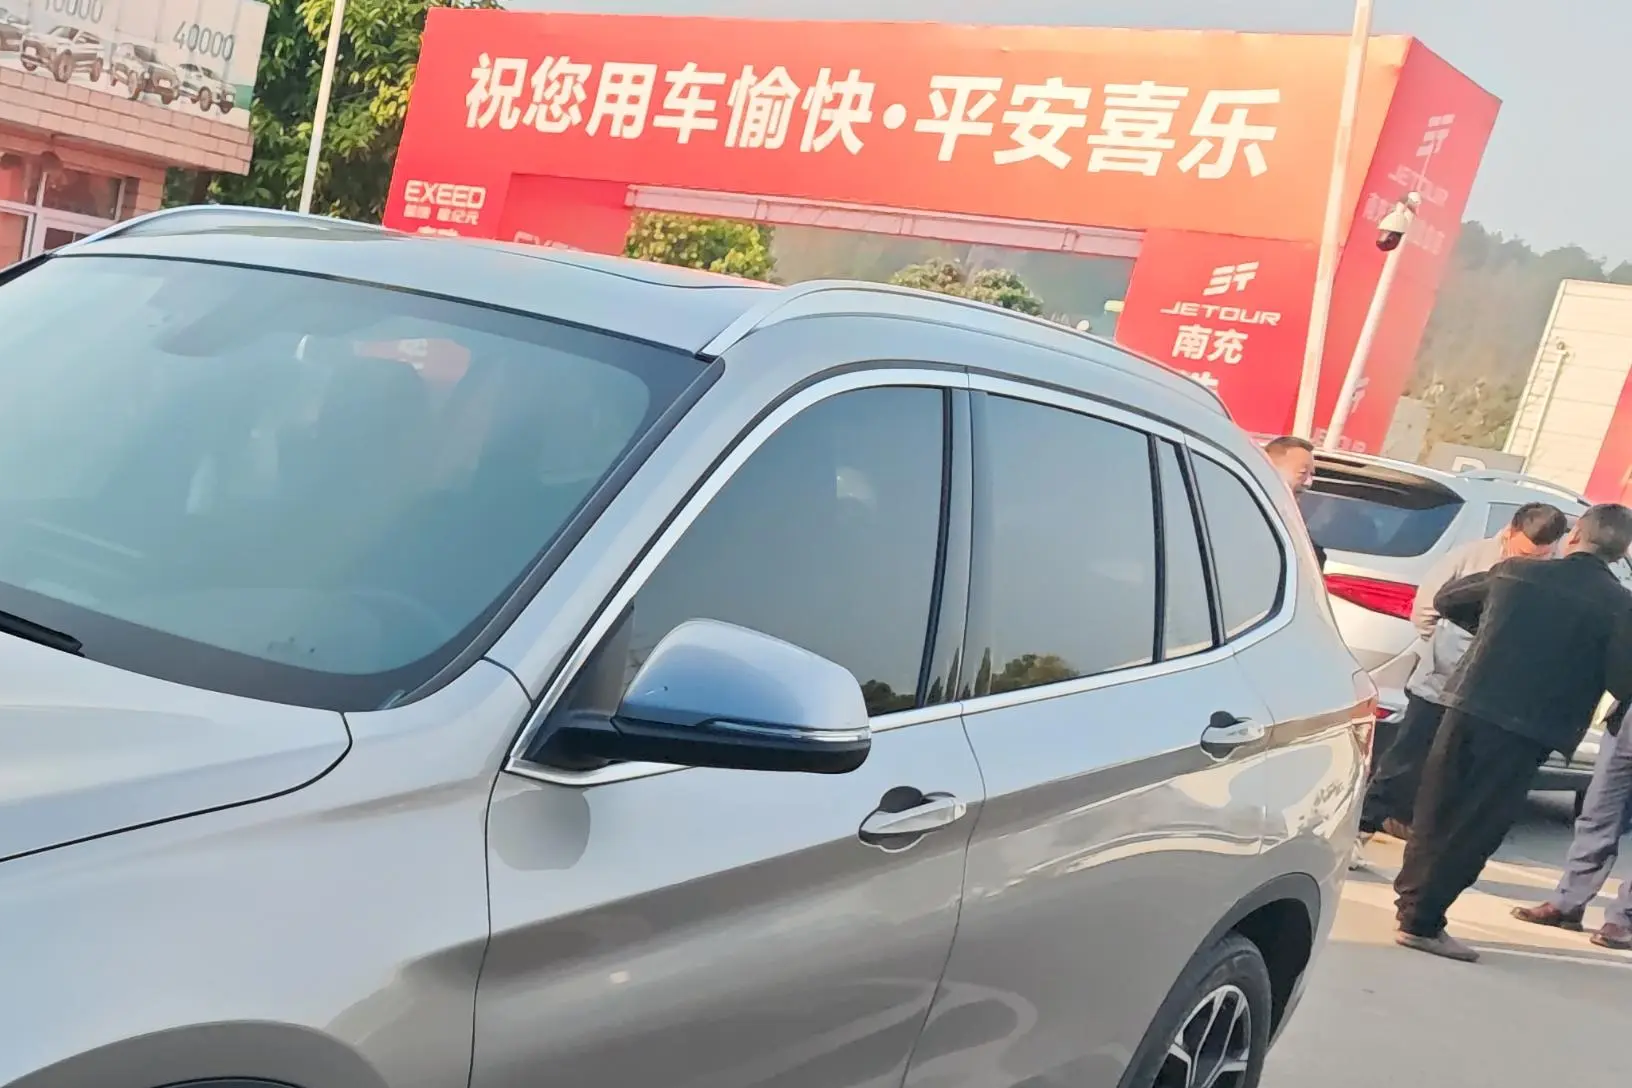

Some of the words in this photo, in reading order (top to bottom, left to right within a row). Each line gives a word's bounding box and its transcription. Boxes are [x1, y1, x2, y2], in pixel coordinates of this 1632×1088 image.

[172, 20, 235, 62] 40000
[403, 179, 487, 210] EXEED
[1159, 300, 1282, 327] JETOUR
[1171, 323, 1249, 365] 南充
